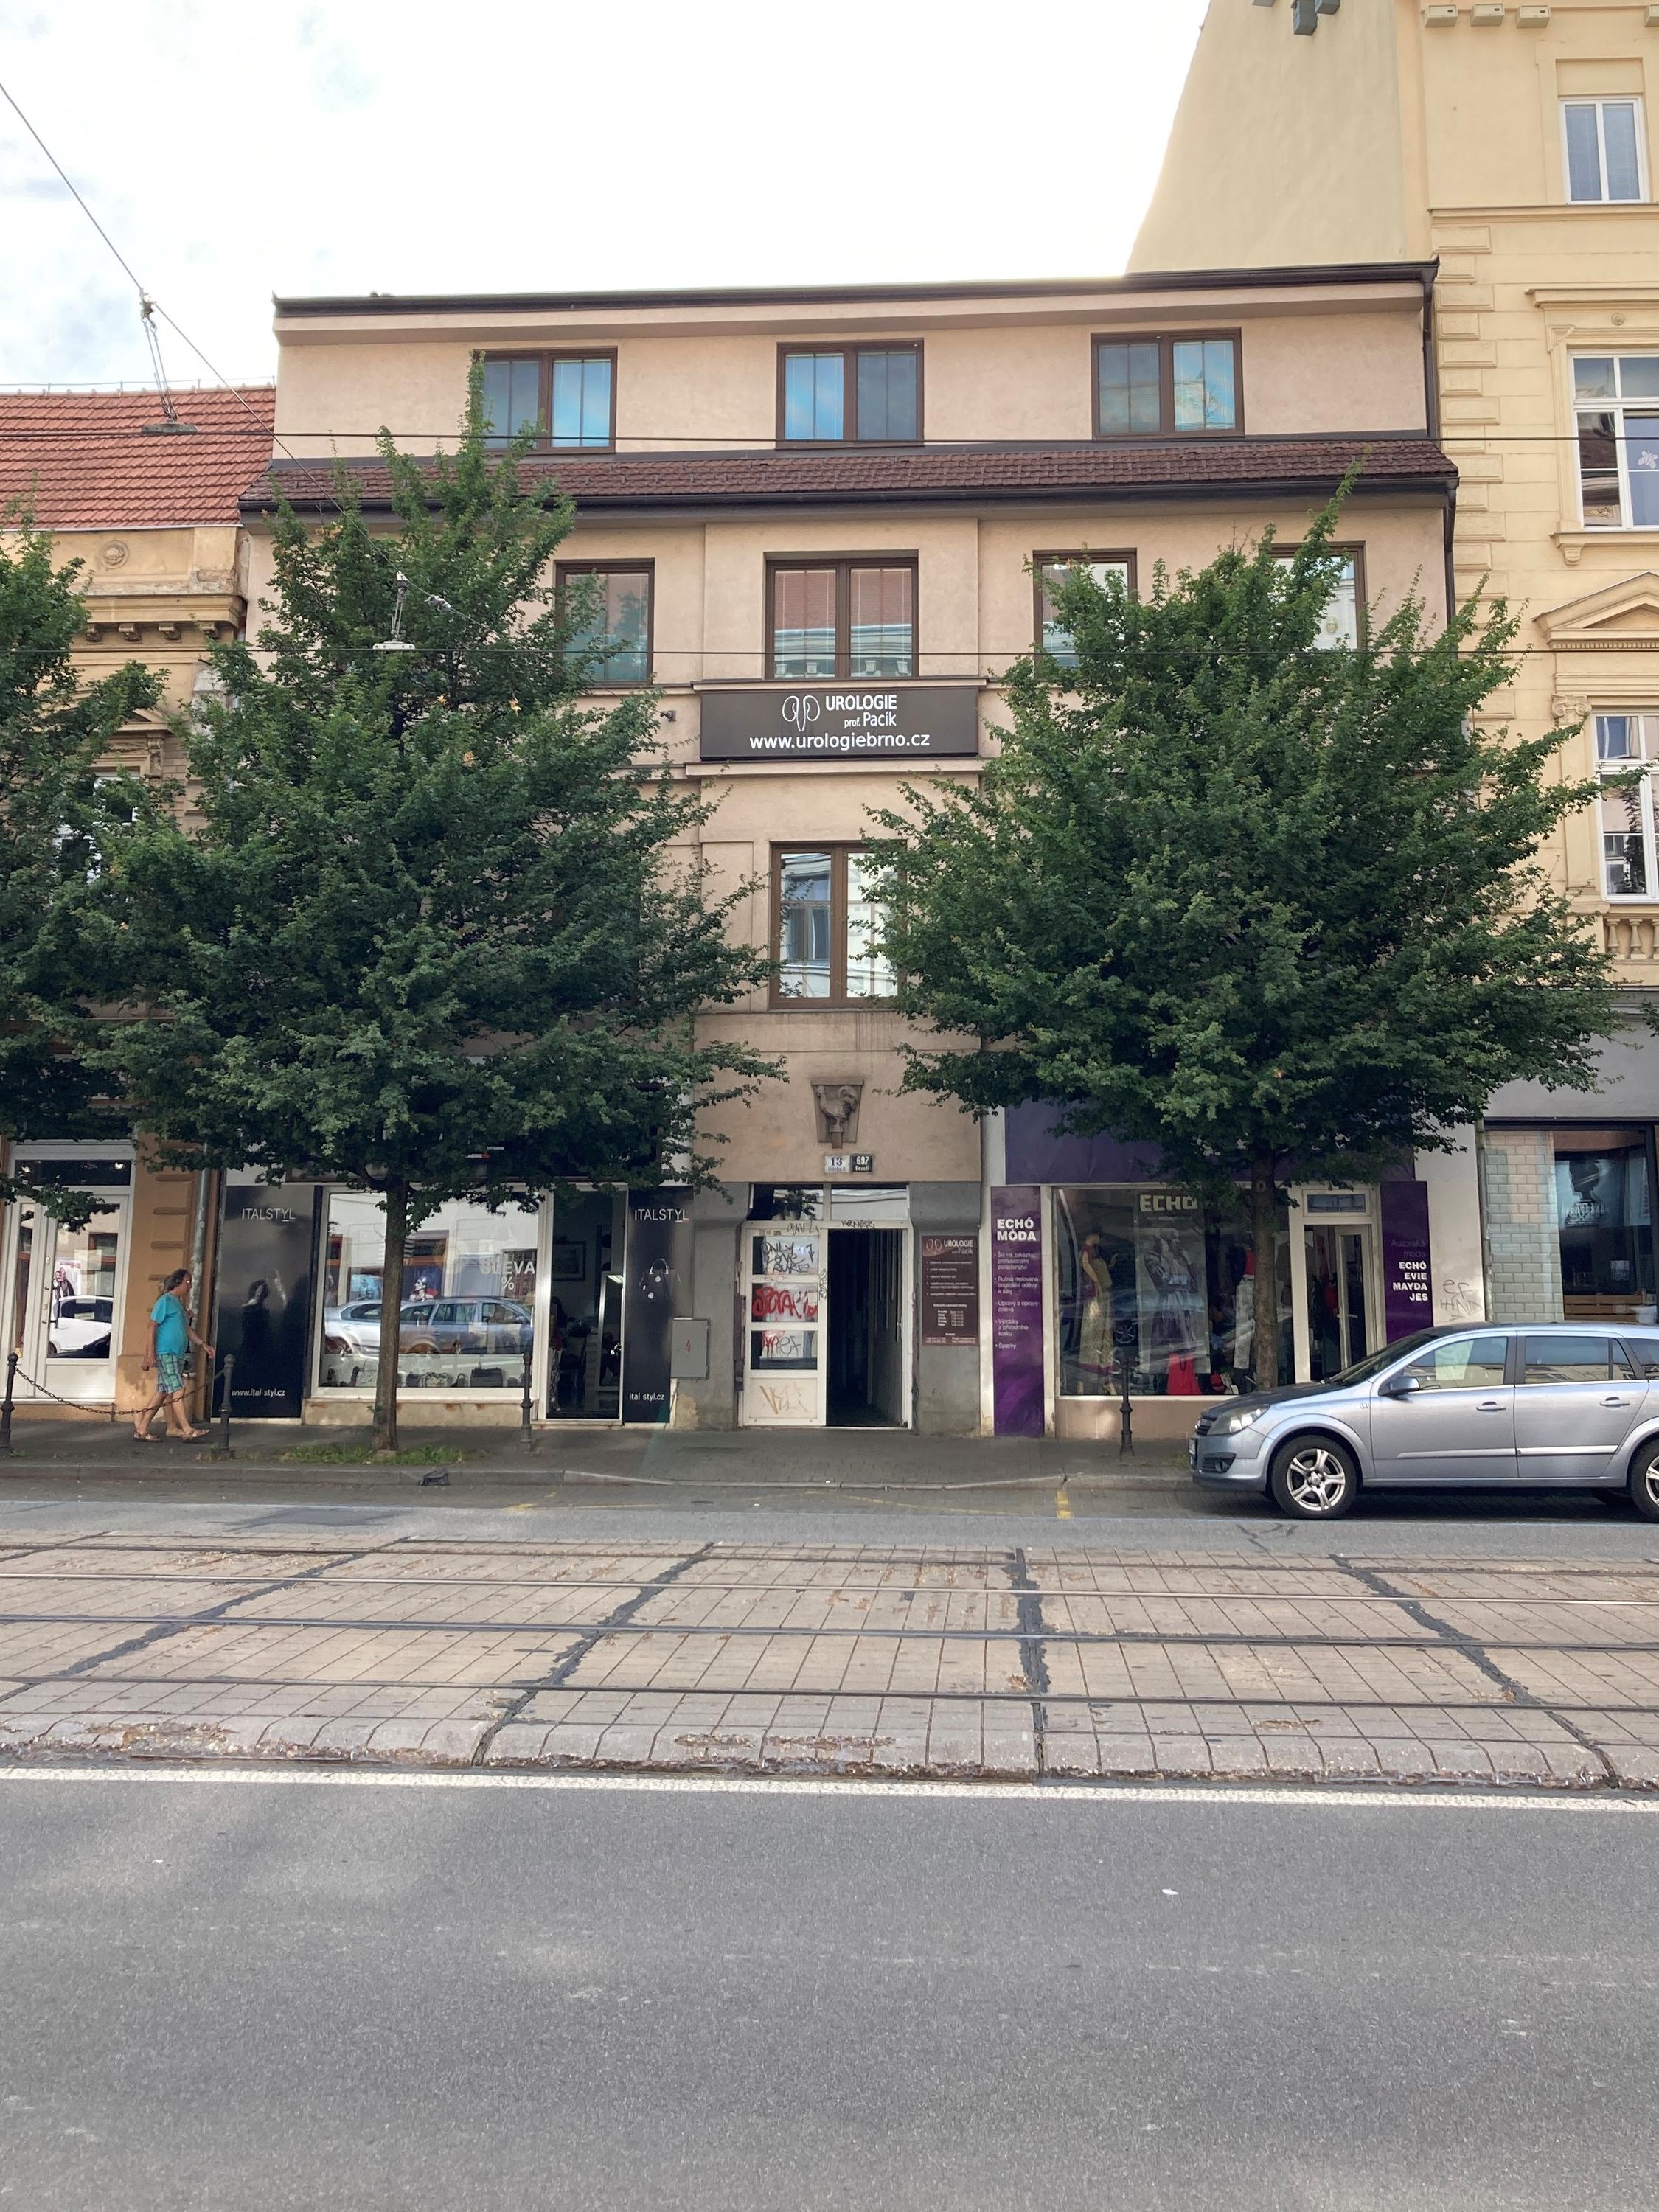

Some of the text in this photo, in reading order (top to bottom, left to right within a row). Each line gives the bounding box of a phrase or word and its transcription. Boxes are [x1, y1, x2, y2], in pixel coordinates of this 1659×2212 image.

[825, 695, 897, 711] UROLOGIE
[844, 712, 897, 729] prof. Pacík
[749, 732, 931, 751] www.urologiebrno.cz
[831, 1157, 843, 1166] 13
[856, 1155, 869, 1165] 697
[242, 1208, 296, 1221] ITALSTYL
[634, 1208, 689, 1222] ITALSTYL
[997, 1217, 1034, 1229] ECHÓ
[997, 1229, 1037, 1241] MÓDA
[944, 1239, 973, 1248] UROLOGIE
[1399, 1260, 1427, 1270] ECHÓ
[1404, 1272, 1427, 1280] EVIE
[501, 1276, 515, 1290] %
[1393, 1282, 1428, 1291] MAYDA
[1409, 1293, 1428, 1301] JES
[629, 1392, 664, 1402] ital styl.cz
